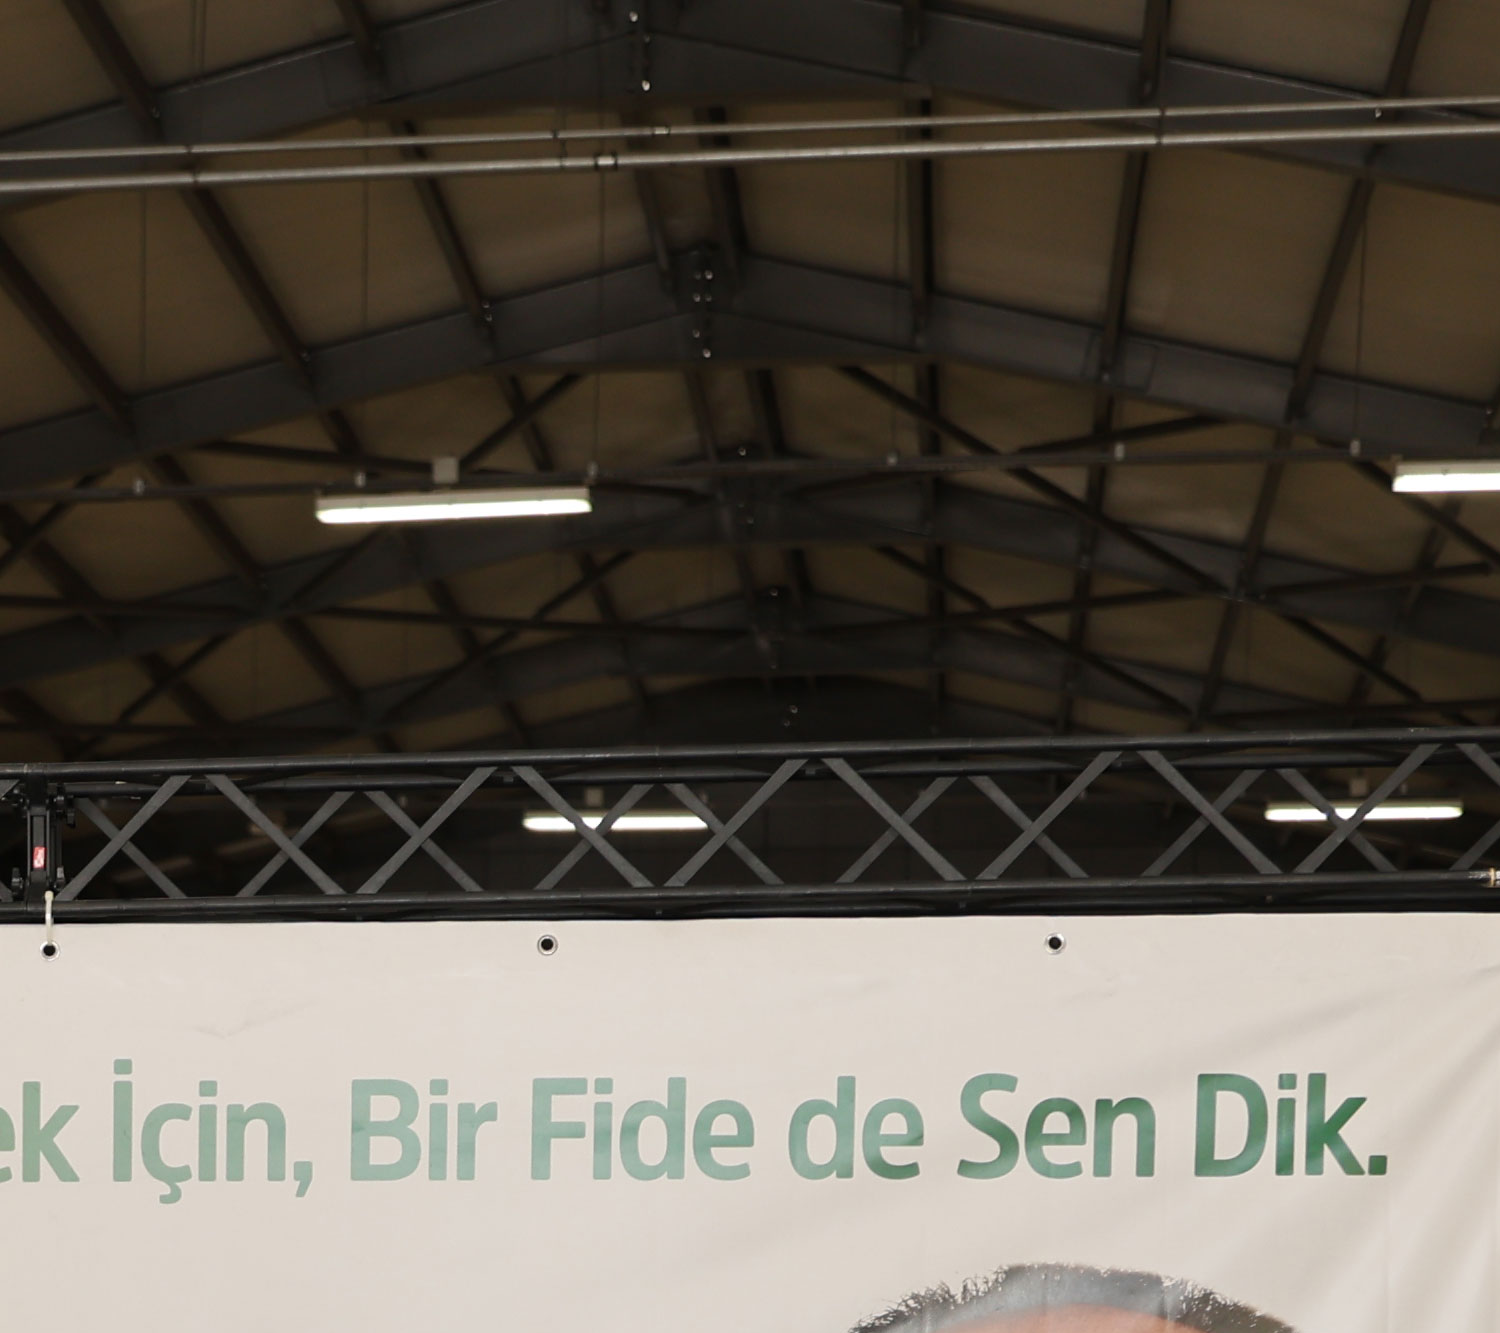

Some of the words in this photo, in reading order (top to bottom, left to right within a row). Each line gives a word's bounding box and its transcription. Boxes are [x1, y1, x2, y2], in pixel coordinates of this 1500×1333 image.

[113, 1059, 313, 1203] İçin,
[351, 1079, 497, 1181] Bir
[531, 1077, 753, 1181] Fide
[788, 1077, 924, 1180] de
[957, 1073, 1156, 1179] Sen
[1194, 1073, 1388, 1178] Dik.
